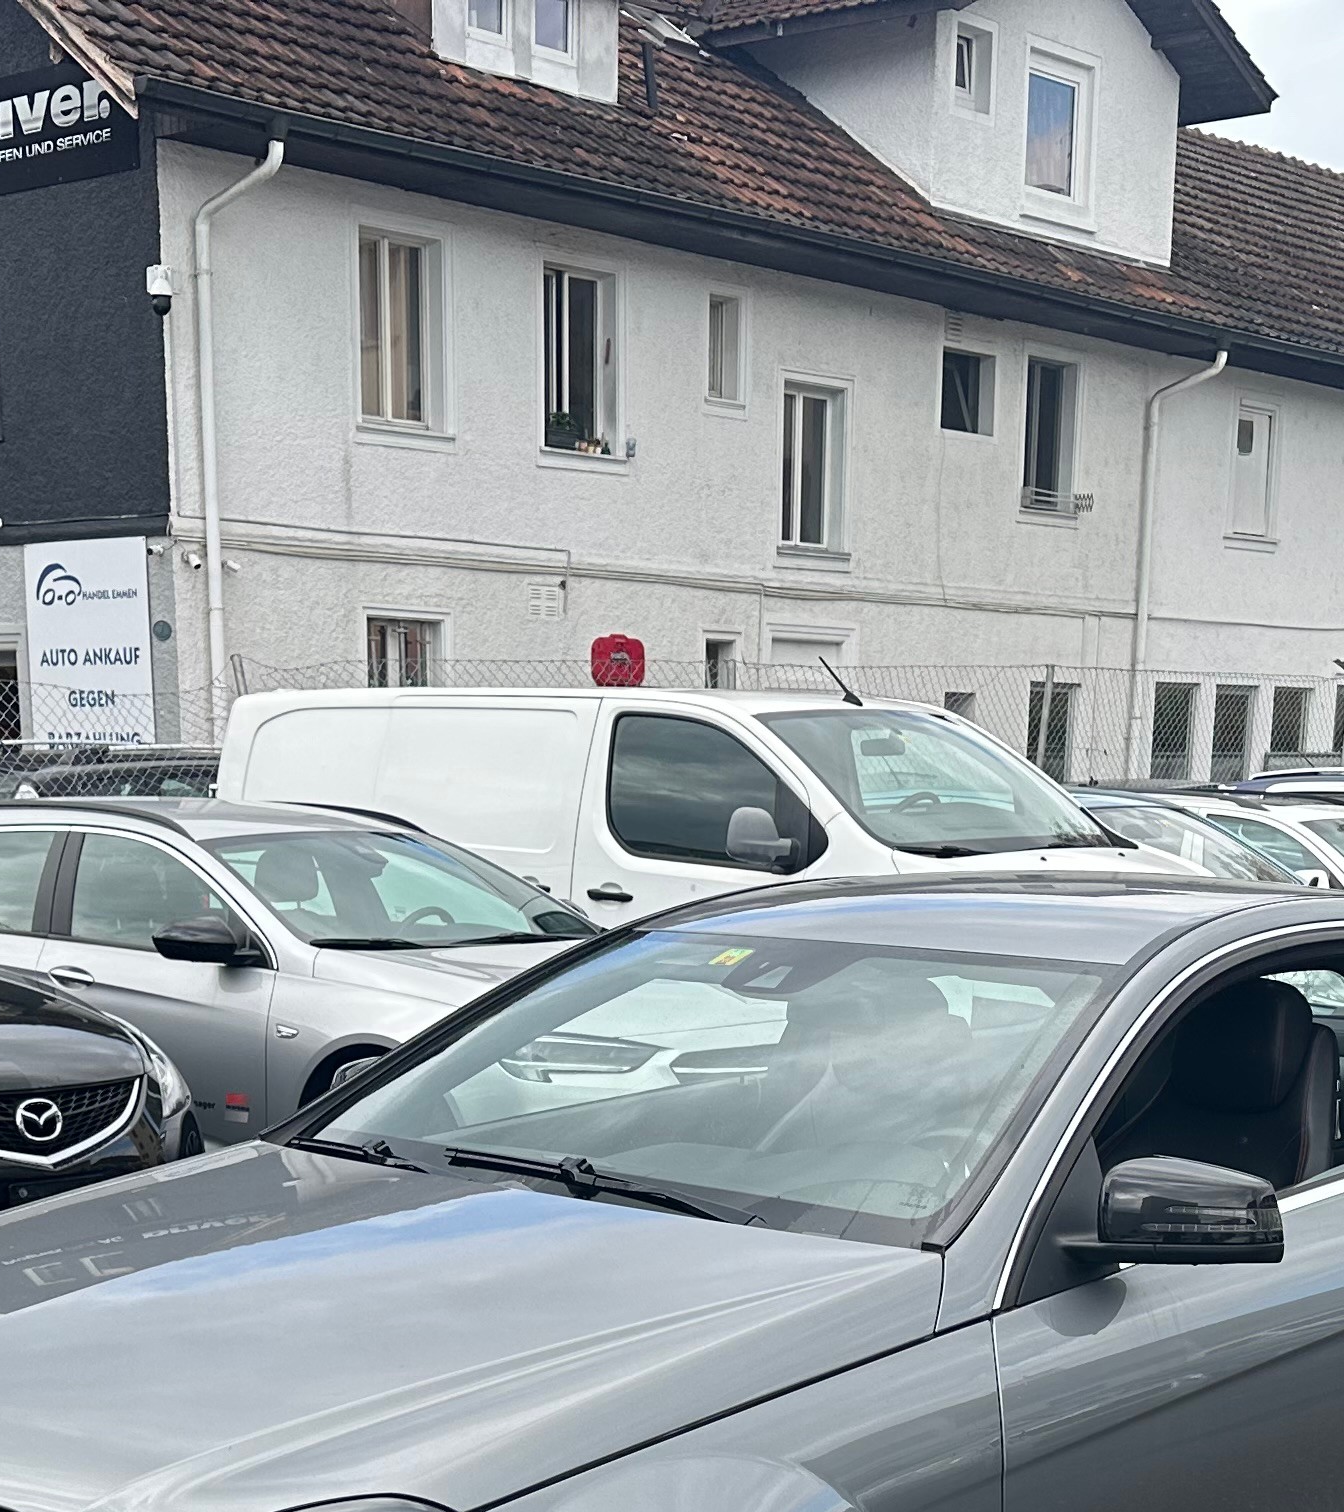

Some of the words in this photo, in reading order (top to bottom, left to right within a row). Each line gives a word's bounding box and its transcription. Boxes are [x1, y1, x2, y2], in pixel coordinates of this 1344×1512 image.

[26, 140, 54, 158] UND
[56, 127, 112, 152] SERVICE
[40, 648, 78, 667] AUTO
[83, 647, 140, 666] ANKAUF
[68, 690, 116, 708] GEGEN
